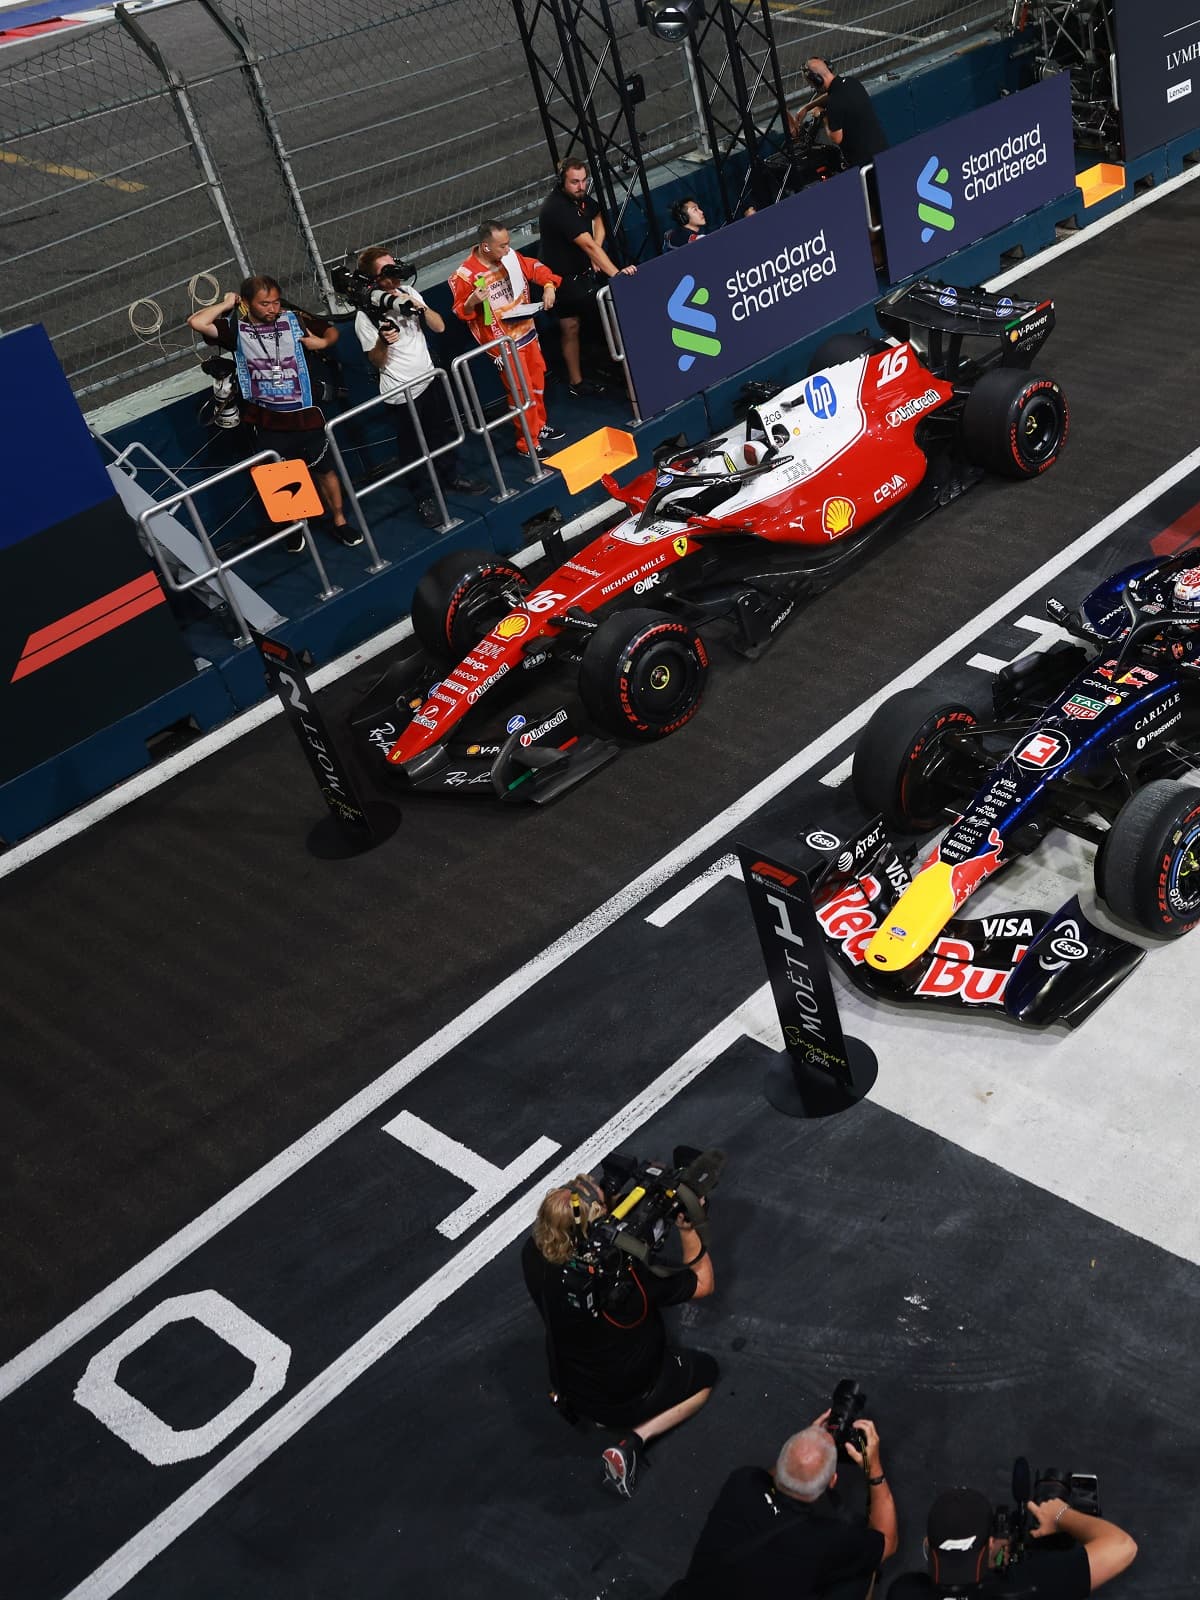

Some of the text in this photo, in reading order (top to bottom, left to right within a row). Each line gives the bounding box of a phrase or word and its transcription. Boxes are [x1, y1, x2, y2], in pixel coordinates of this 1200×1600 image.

[1168, 83, 1190, 98] Lenovo
[961, 123, 1041, 181] standard
[963, 144, 1048, 201] chartered
[725, 229, 828, 299] standard
[731, 249, 837, 323] chartered
[1017, 315, 1048, 338] V-Power
[876, 345, 908, 388] 16
[811, 380, 831, 418] hp
[896, 389, 941, 422] UniCredit
[702, 474, 741, 487] DXC
[601, 553, 667, 596] RICHARD MILLE
[526, 589, 567, 613] 16
[279, 671, 309, 713] 2
[452, 668, 479, 683] WHOOP
[475, 663, 510, 698] UniCredit
[1082, 678, 1130, 698] ORACLE
[618, 677, 639, 722] ZERO
[1064, 703, 1098, 719] HEUER
[1074, 696, 1104, 711] TAG
[1134, 693, 1181, 731] CARLYLE
[368, 722, 396, 757] Ray-Ba
[529, 708, 568, 742] UniCredit
[1146, 712, 1182, 743] 1Password
[1017, 732, 1062, 768] 3
[1000, 778, 1018, 790] VISA
[975, 806, 999, 820] TRADE
[992, 799, 1008, 808] AT&T
[811, 834, 835, 848] Esso
[855, 826, 882, 860] AT&T
[947, 839, 972, 853] PIRELLI
[959, 825, 983, 838] CARLYLE
[941, 847, 960, 859] Mobil
[884, 855, 913, 898] VISA
[1157, 854, 1173, 924] P ZERO
[767, 893, 804, 948] 1
[981, 917, 1034, 937] VISA
[1056, 939, 1083, 957] Esso
[784, 949, 826, 1042] MOËT
